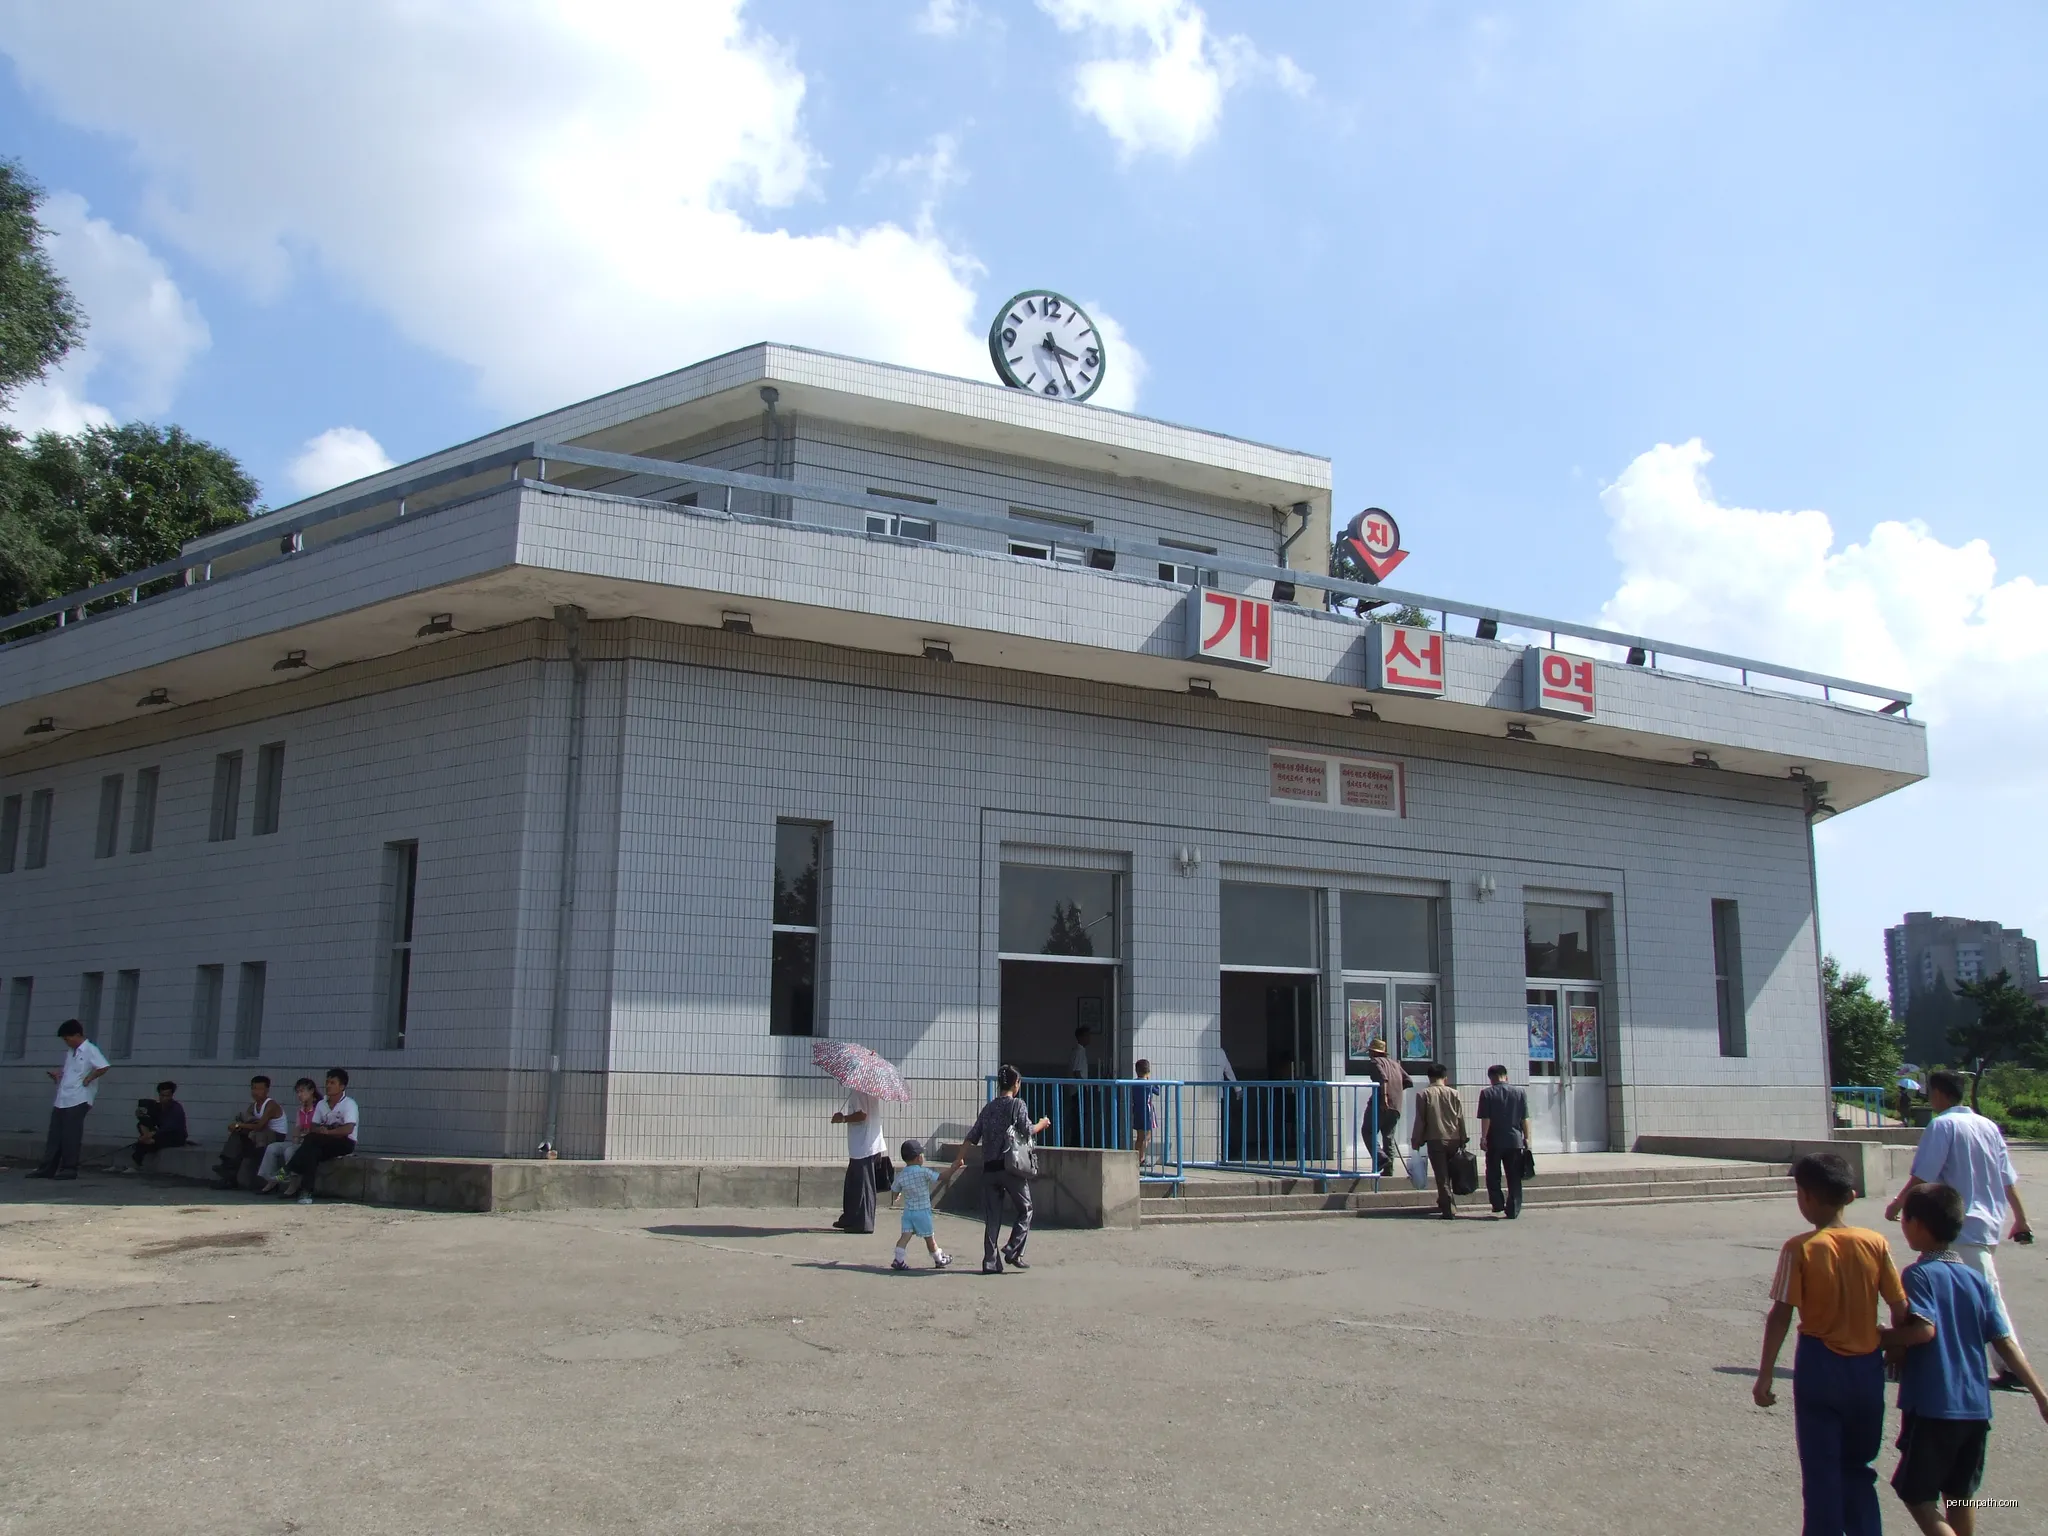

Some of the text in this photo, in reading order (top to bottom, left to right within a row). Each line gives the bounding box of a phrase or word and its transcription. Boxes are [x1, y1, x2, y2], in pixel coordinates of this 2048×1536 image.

[1043, 297, 1061, 318] 12
[1003, 328, 1017, 348] 9
[1086, 347, 1099, 367] 3
[1045, 379, 1059, 396] 6
[1367, 520, 1388, 547] 지
